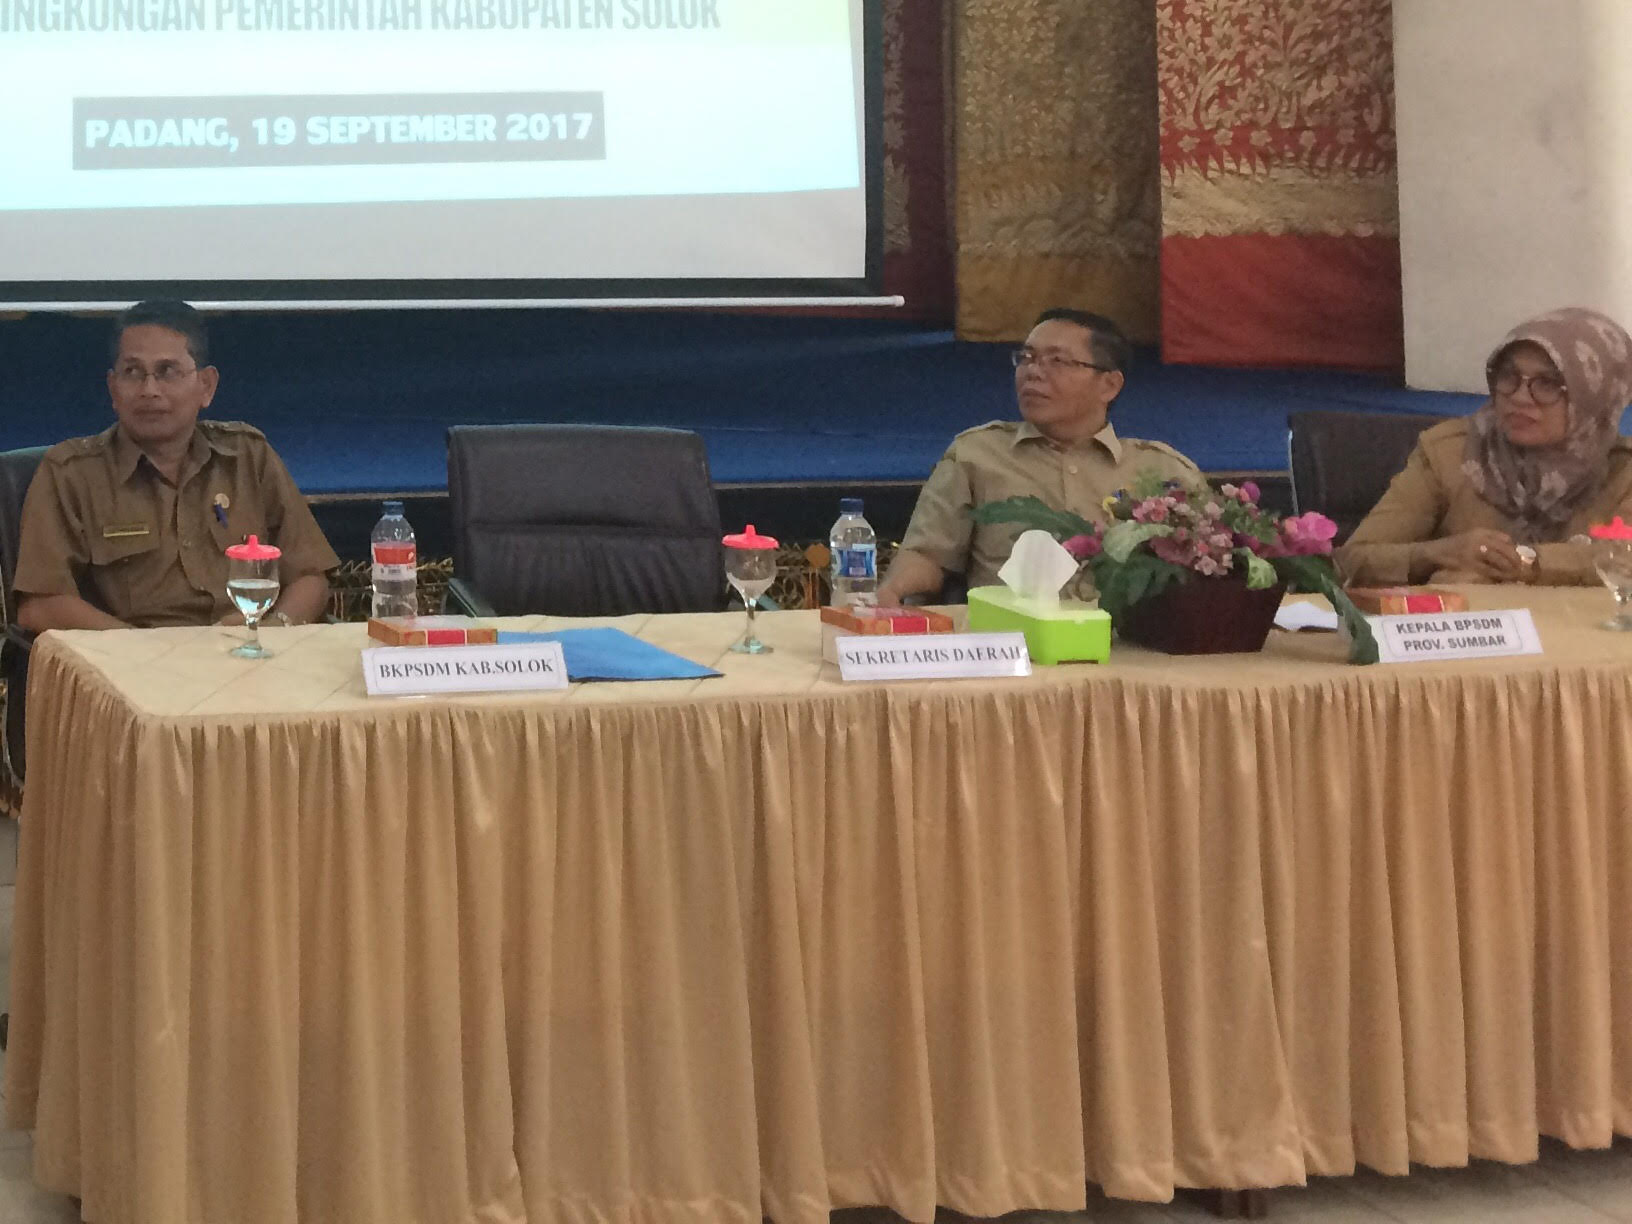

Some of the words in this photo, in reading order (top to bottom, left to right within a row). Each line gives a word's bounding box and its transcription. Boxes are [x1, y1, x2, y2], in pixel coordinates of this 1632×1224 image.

[85, 118, 239, 153] PADANG,
[253, 117, 296, 146] 19
[306, 114, 497, 145] SEPTEMBER
[505, 113, 593, 142] 2017
[1396, 621, 1452, 635] KEPALA
[1454, 617, 1503, 631] BPSDM
[1403, 638, 1445, 652] PROV.
[1447, 634, 1506, 649] SUMBAR
[845, 648, 950, 665] SEKRETARIS
[379, 662, 450, 679] BKPSDM
